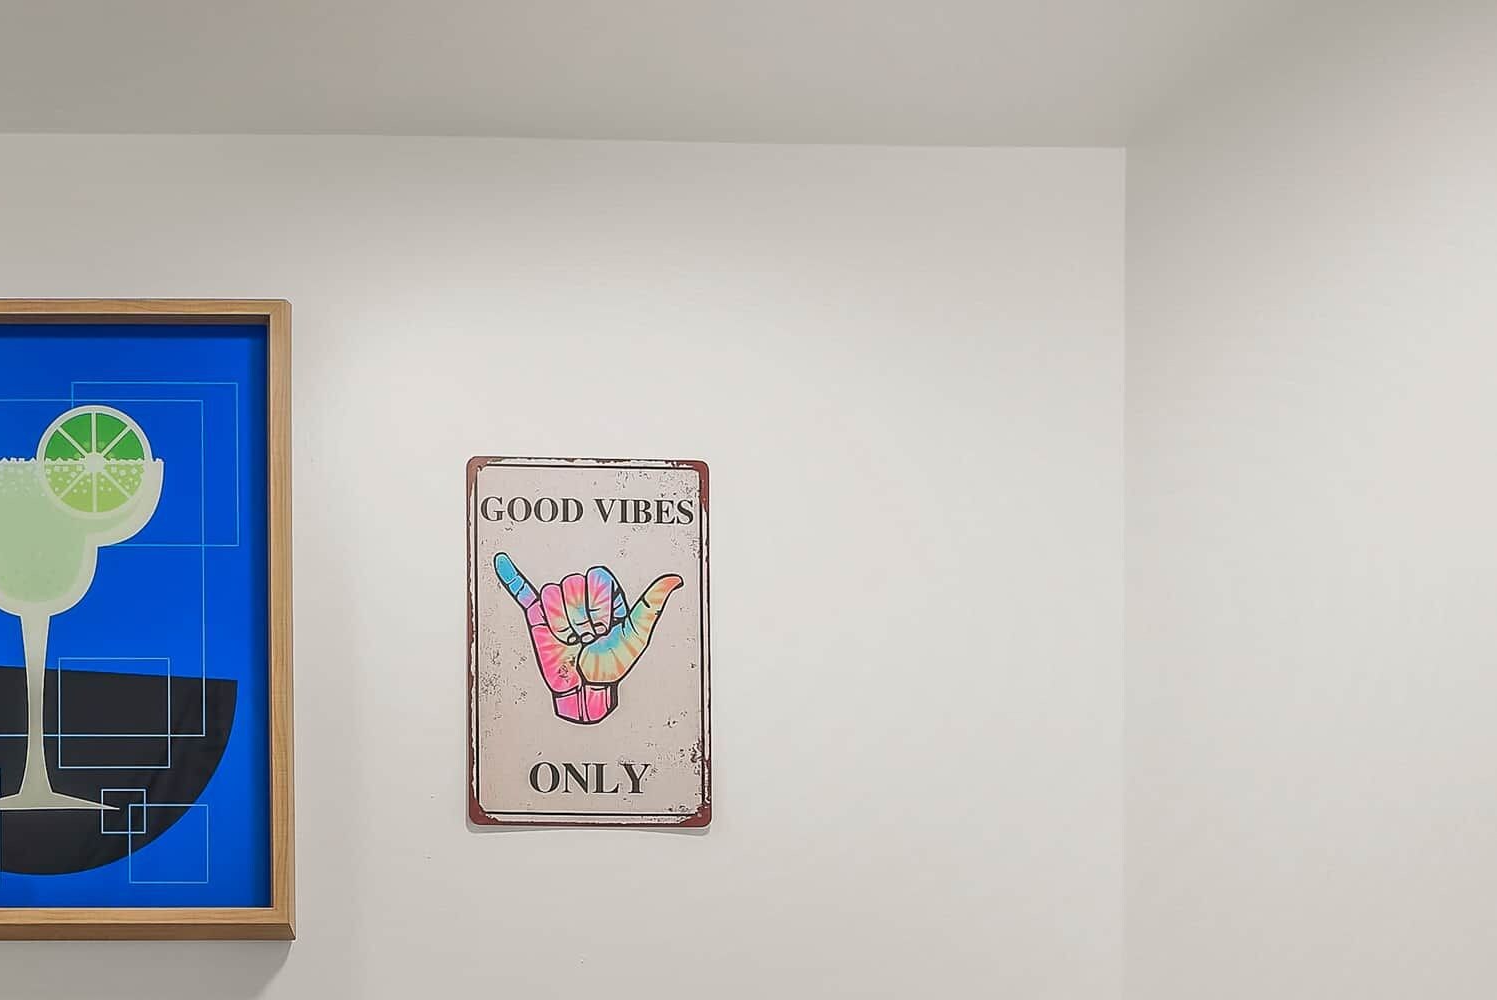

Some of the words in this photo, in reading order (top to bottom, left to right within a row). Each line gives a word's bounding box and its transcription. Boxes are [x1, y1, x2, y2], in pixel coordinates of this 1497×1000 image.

[480, 496, 584, 523] GOOD
[593, 499, 694, 525] VIBES
[529, 762, 650, 794] ONLY
